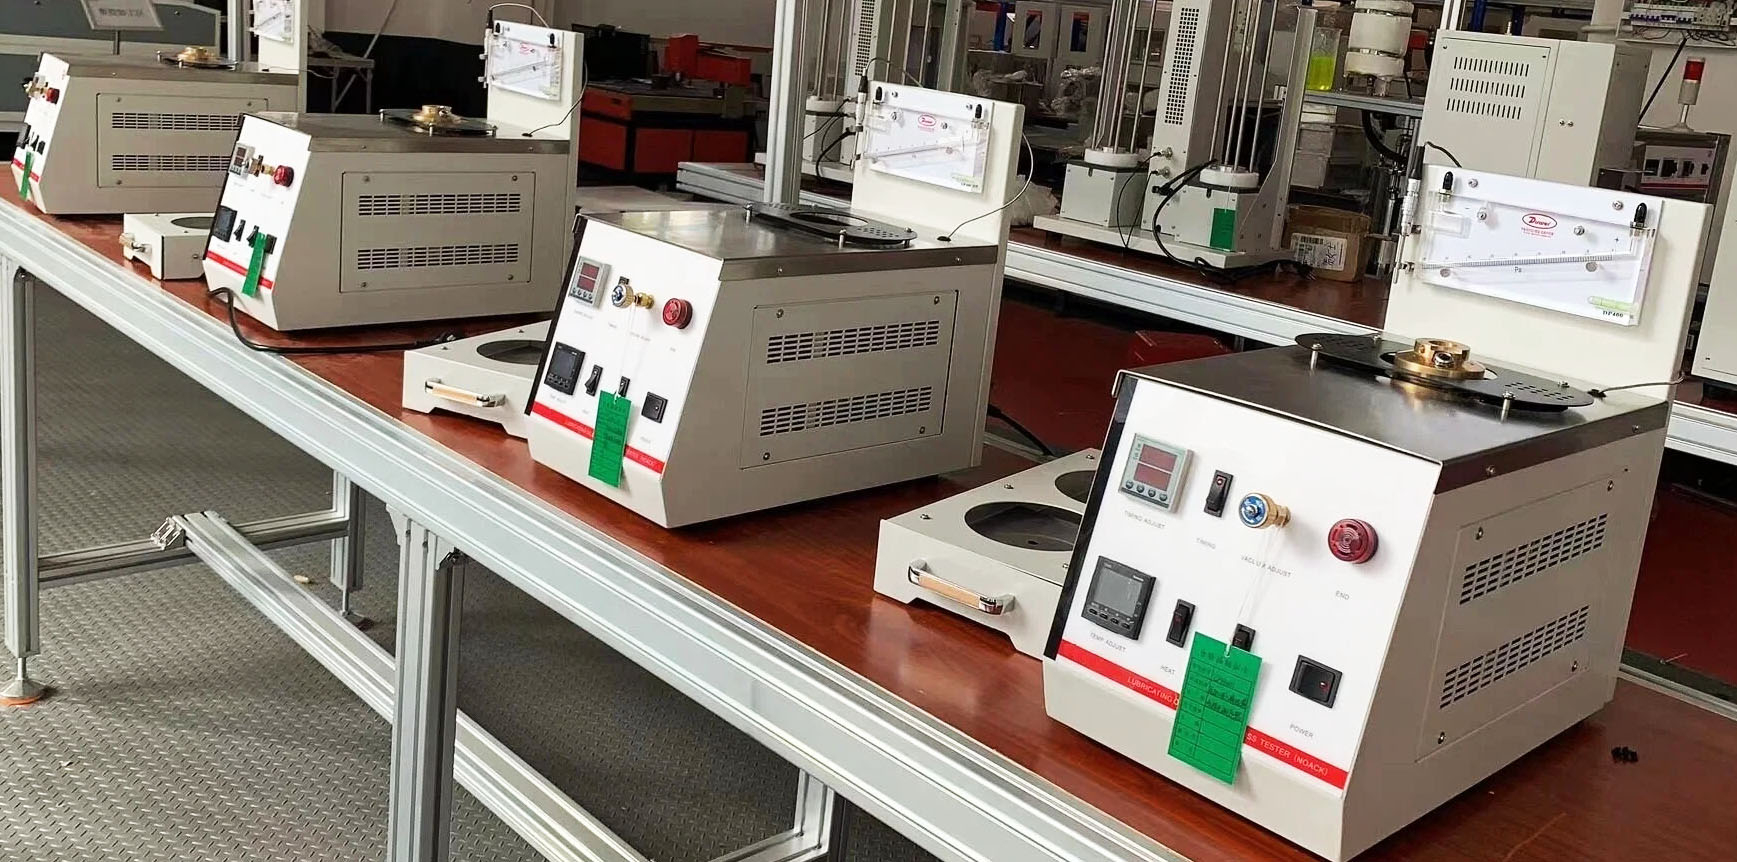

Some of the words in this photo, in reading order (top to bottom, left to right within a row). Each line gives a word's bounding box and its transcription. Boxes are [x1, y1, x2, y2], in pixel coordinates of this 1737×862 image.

[1144, 517, 1166, 530] ADJUST
[1267, 563, 1292, 578] ADJUST
[1335, 590, 1350, 601] END
[1105, 639, 1127, 653] ADJUST
[1160, 664, 1176, 676] HEAT
[1127, 675, 1172, 704] LUBRICATING
[1246, 732, 1257, 743] SS
[1260, 738, 1291, 758] TESTER
[1293, 754, 1329, 777] (NOACK)
[1289, 723, 1314, 738] POWER
